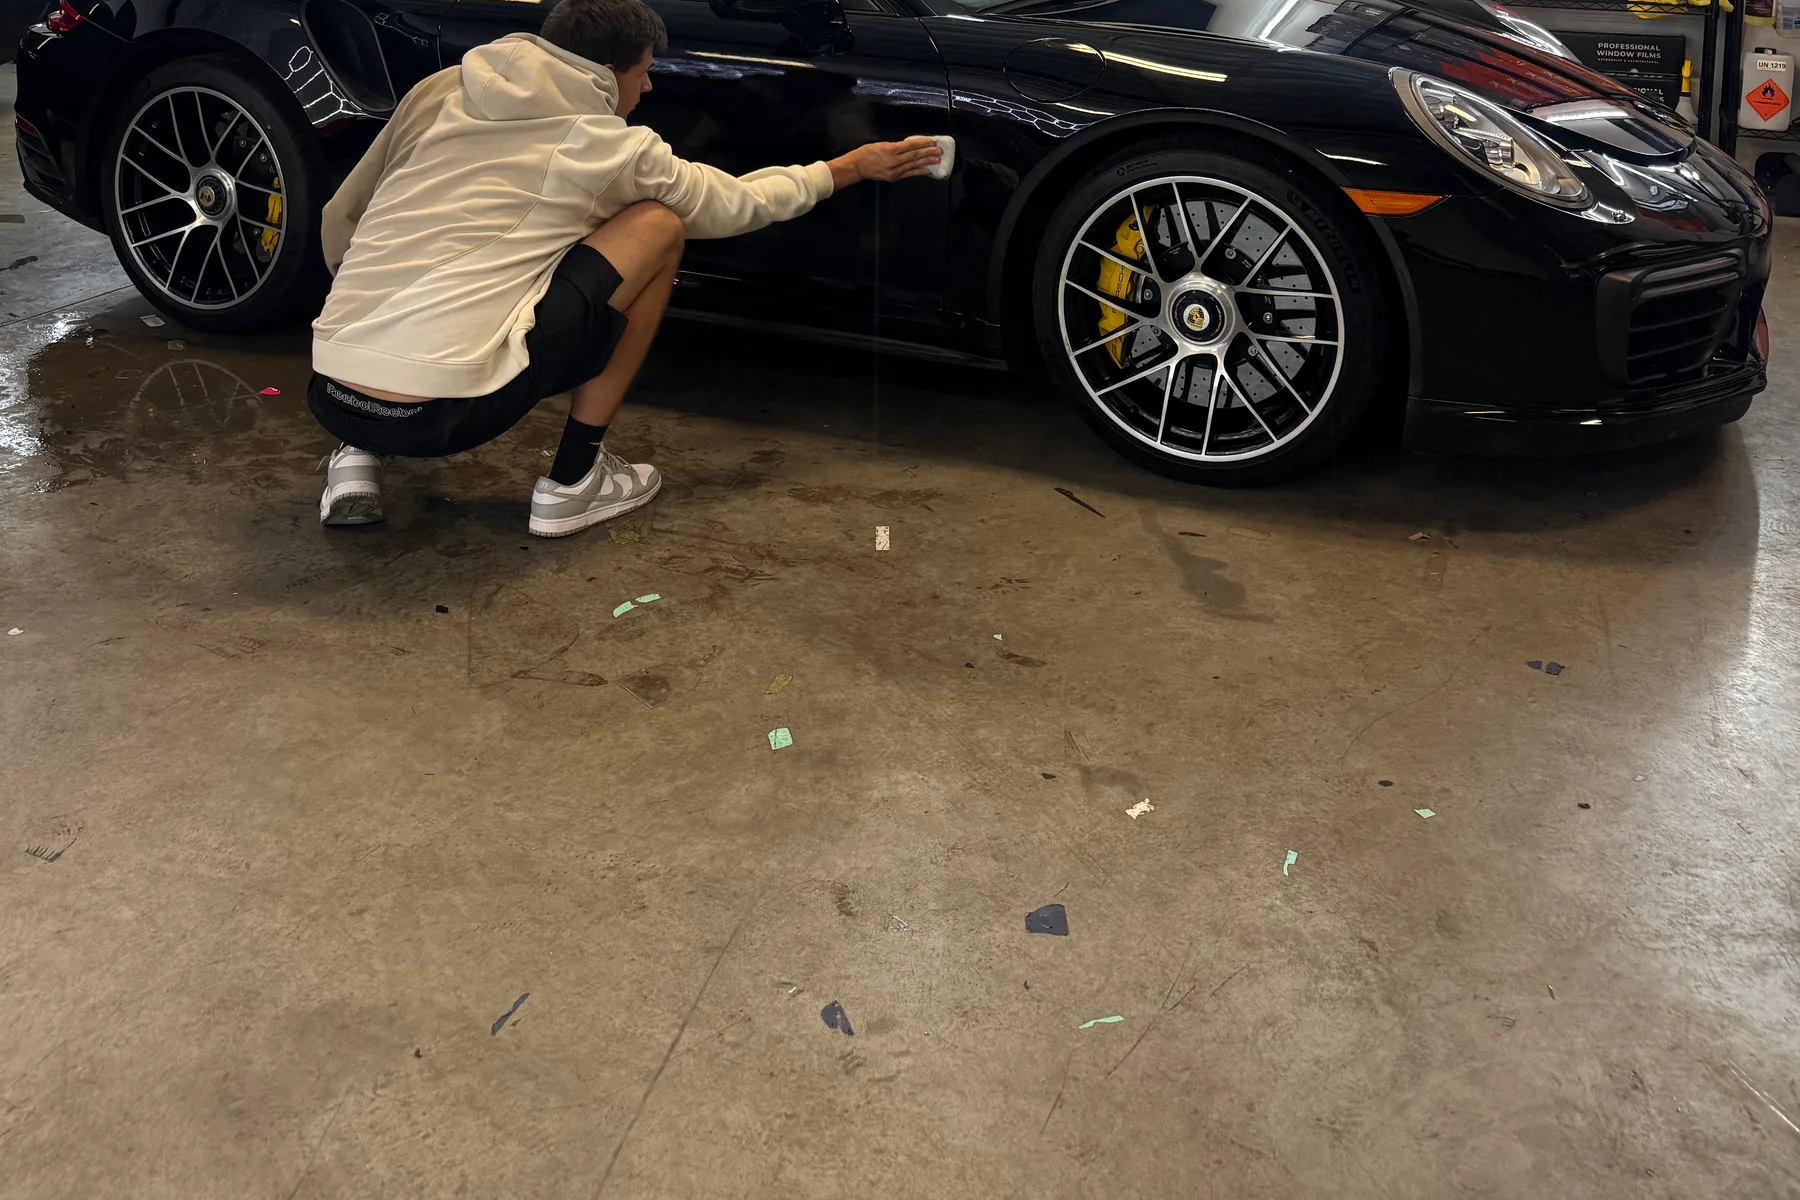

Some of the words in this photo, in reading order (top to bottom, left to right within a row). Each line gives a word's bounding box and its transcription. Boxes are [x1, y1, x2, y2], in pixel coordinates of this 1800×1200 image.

[1597, 42, 1661, 52] PROFESSIONAL
[1596, 49, 1635, 58] WINDOW
[1636, 51, 1662, 59] FILMS
